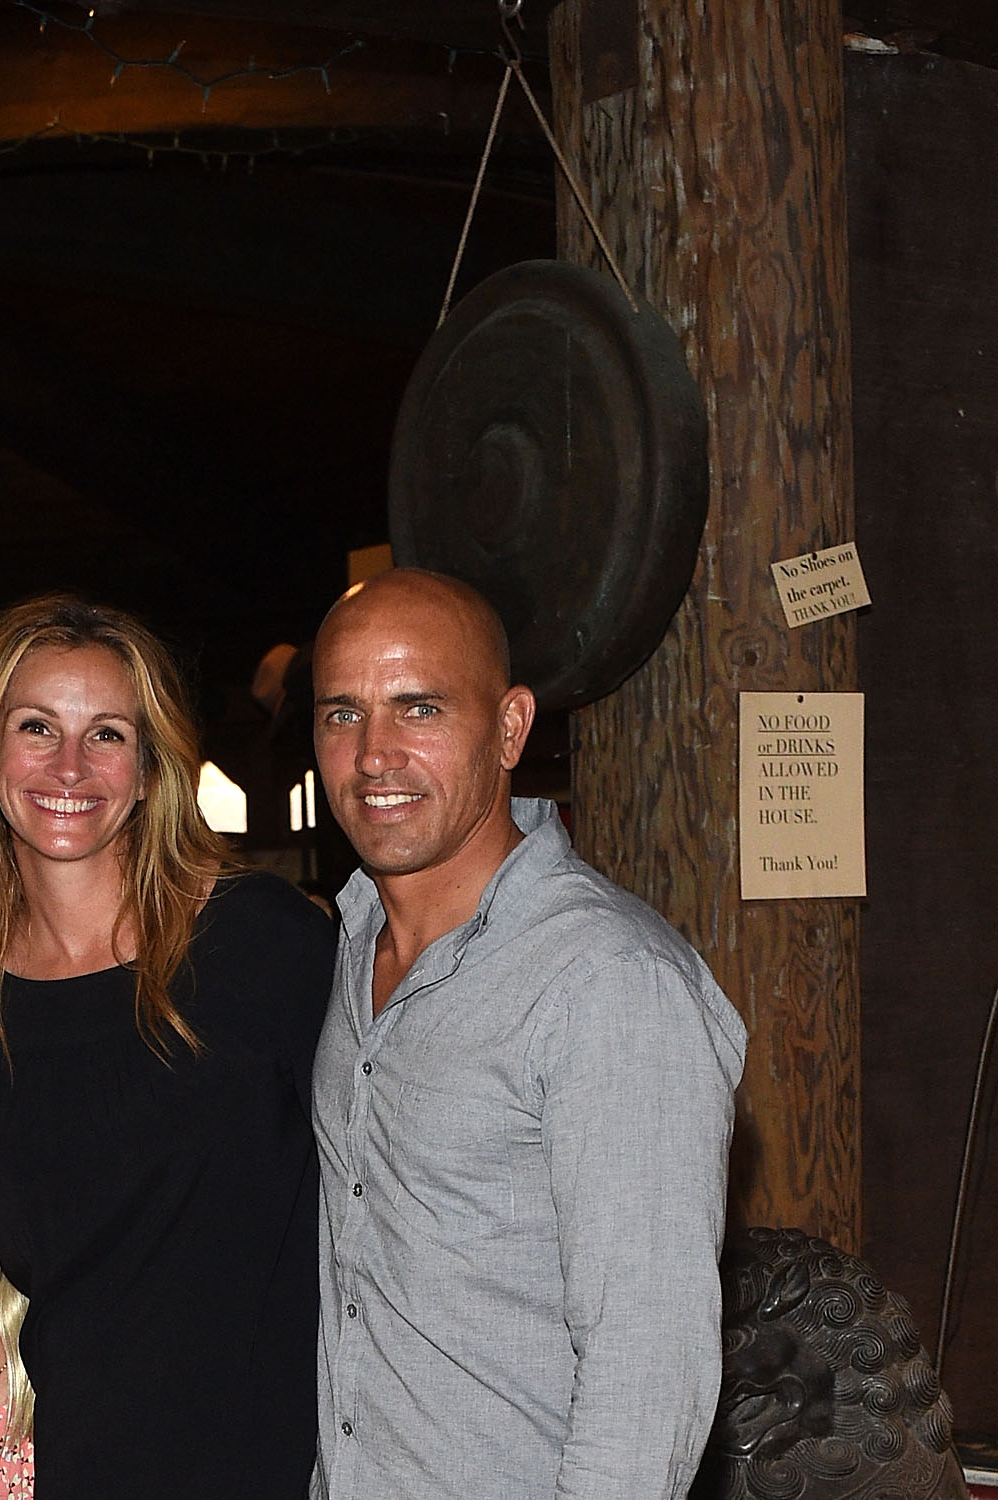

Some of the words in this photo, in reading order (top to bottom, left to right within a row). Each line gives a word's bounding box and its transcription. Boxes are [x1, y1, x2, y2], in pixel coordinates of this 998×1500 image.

[780, 563, 798, 577] No
[800, 555, 836, 574] Shoes
[838, 551, 854, 563] on
[787, 587, 807, 603] the
[810, 576, 850, 596] carpet.
[793, 601, 829, 621] THANK
[830, 592, 857, 609] YOU!
[758, 715, 780, 730] NO
[785, 715, 830, 730] FOOD
[758, 743, 773, 754] or
[777, 738, 835, 753] DRINKS
[758, 762, 838, 777] ALLOWED
[759, 785, 773, 800] IN
[778, 785, 811, 800] THE
[759, 808, 818, 824] HOUSE.
[759, 855, 803, 871] Thank
[807, 854, 838, 870] You!
